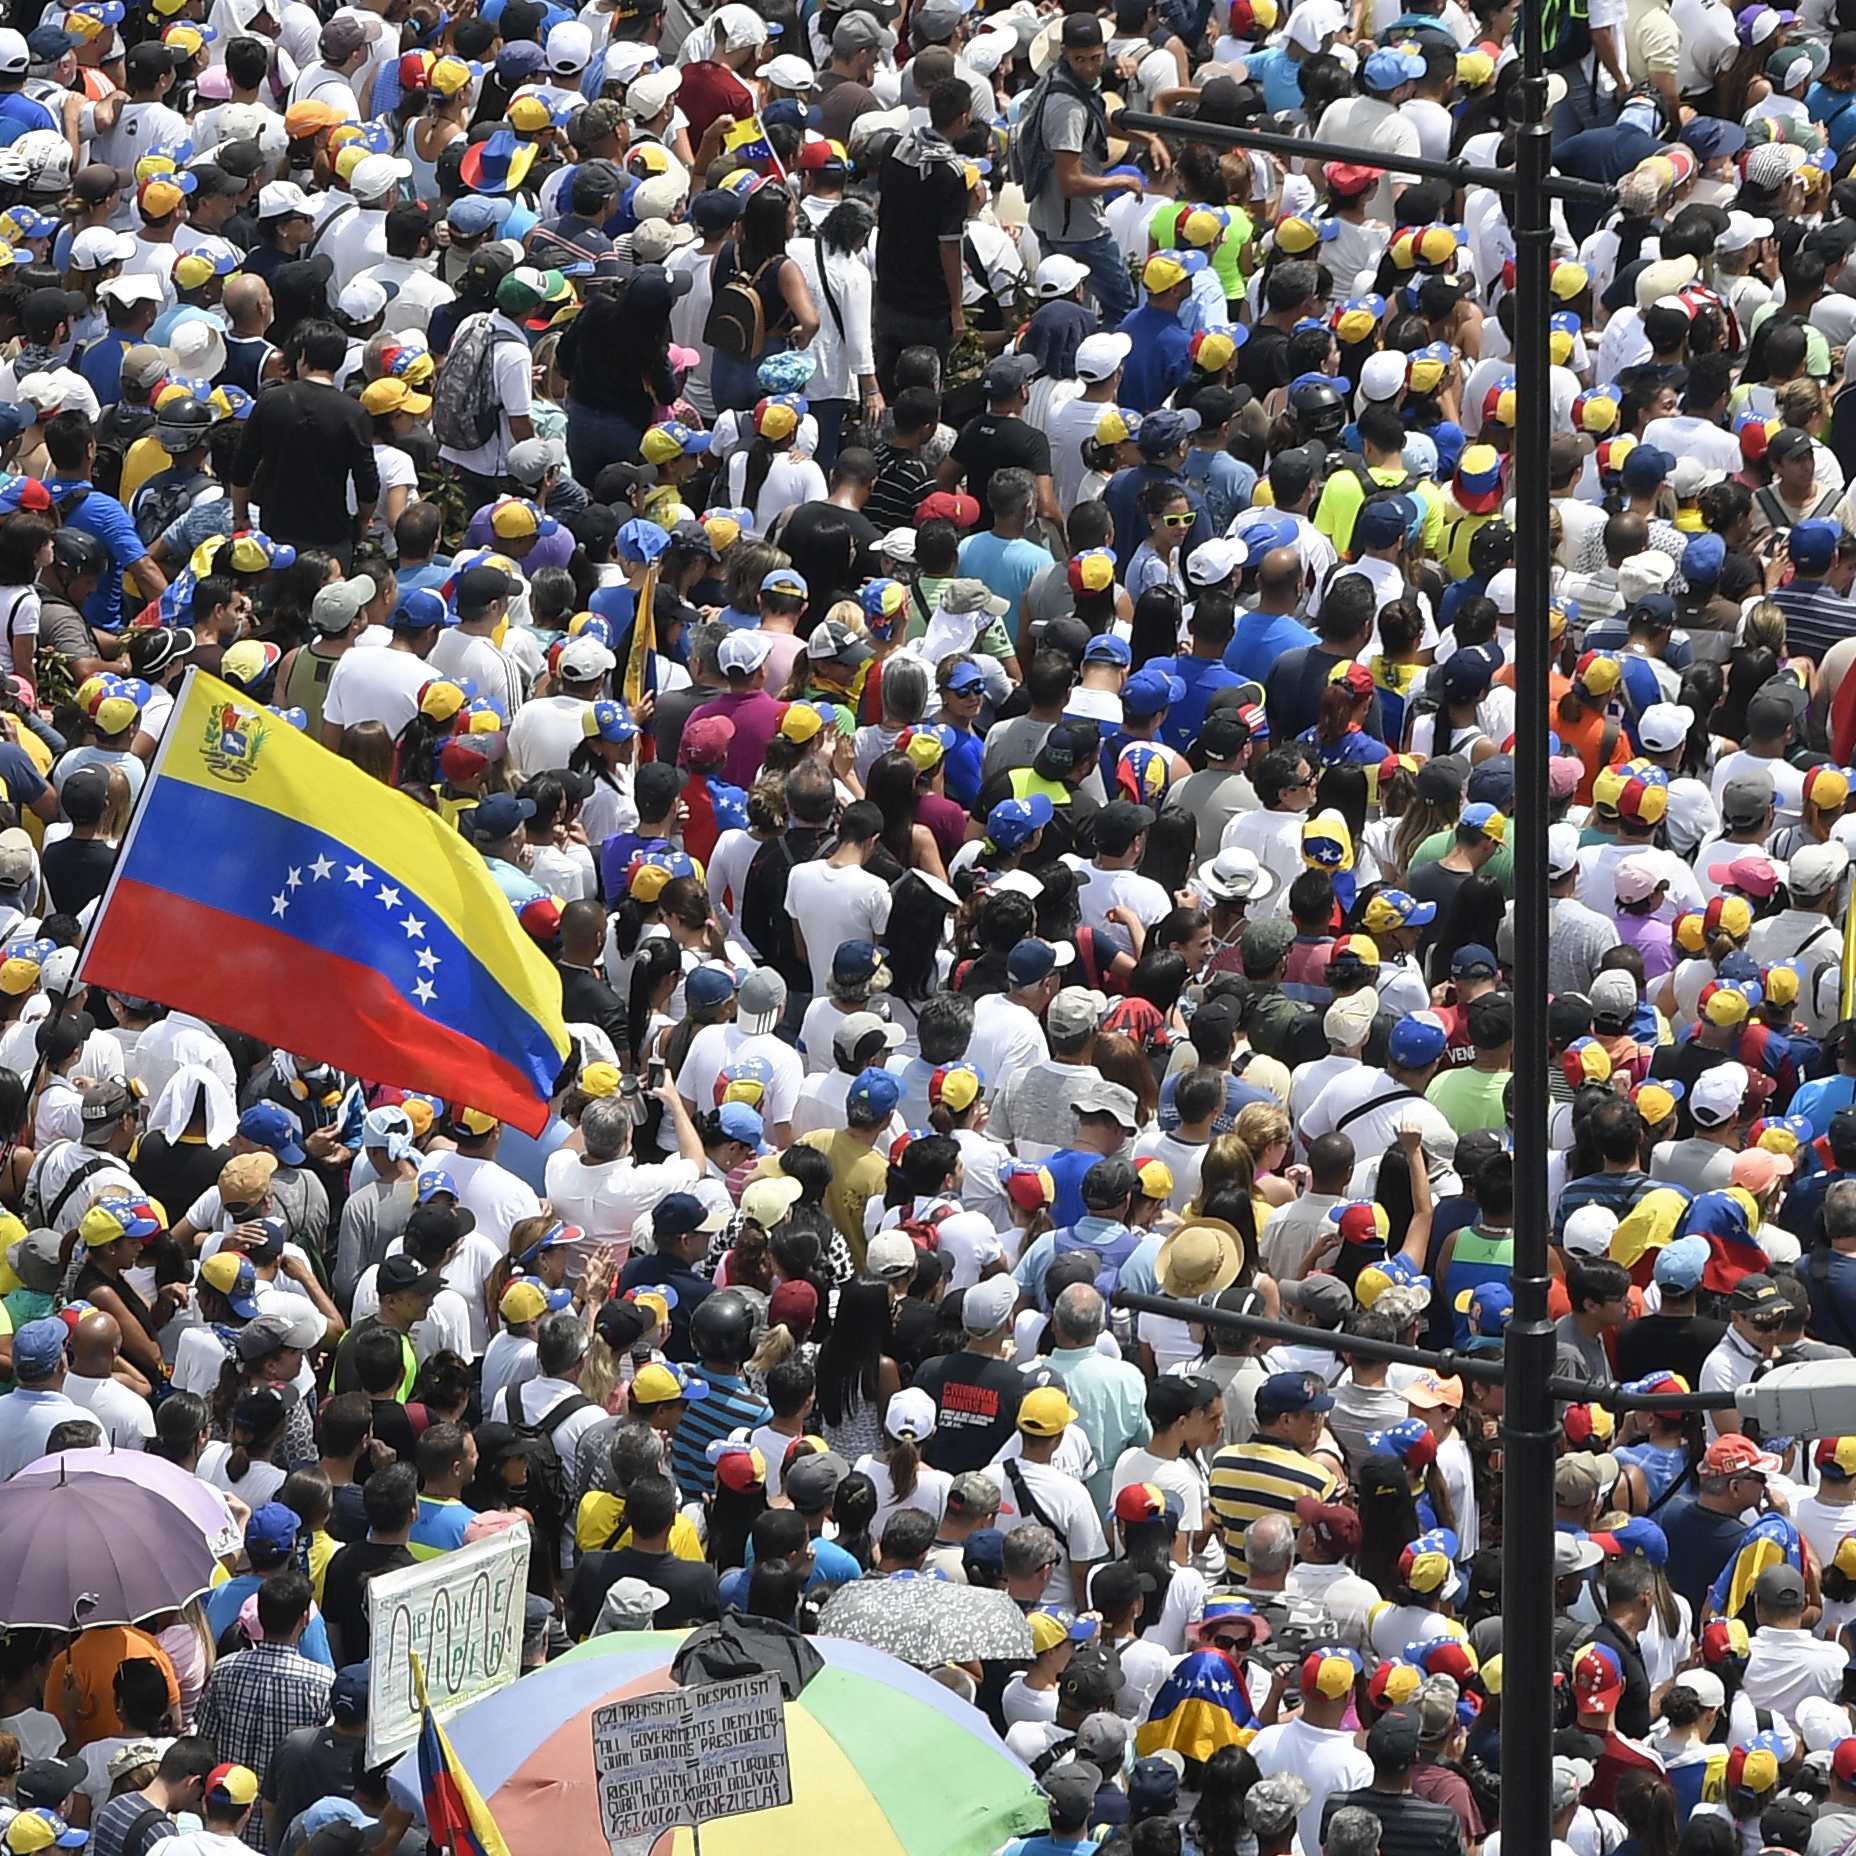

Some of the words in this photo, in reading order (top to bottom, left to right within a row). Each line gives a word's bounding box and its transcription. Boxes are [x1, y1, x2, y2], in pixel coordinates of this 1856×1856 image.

[418, 1626, 513, 1686] IPER!
[696, 1680, 769, 1707] DESPOTISM
[631, 1720, 715, 1748] GOVERNMENTS
[722, 1707, 777, 1731] DENYING
[701, 1722, 778, 1752] PRESIDENCY
[650, 1774, 690, 1792] CHINA
[642, 1806, 664, 1827] OUT
[666, 1805, 682, 1822] OF
